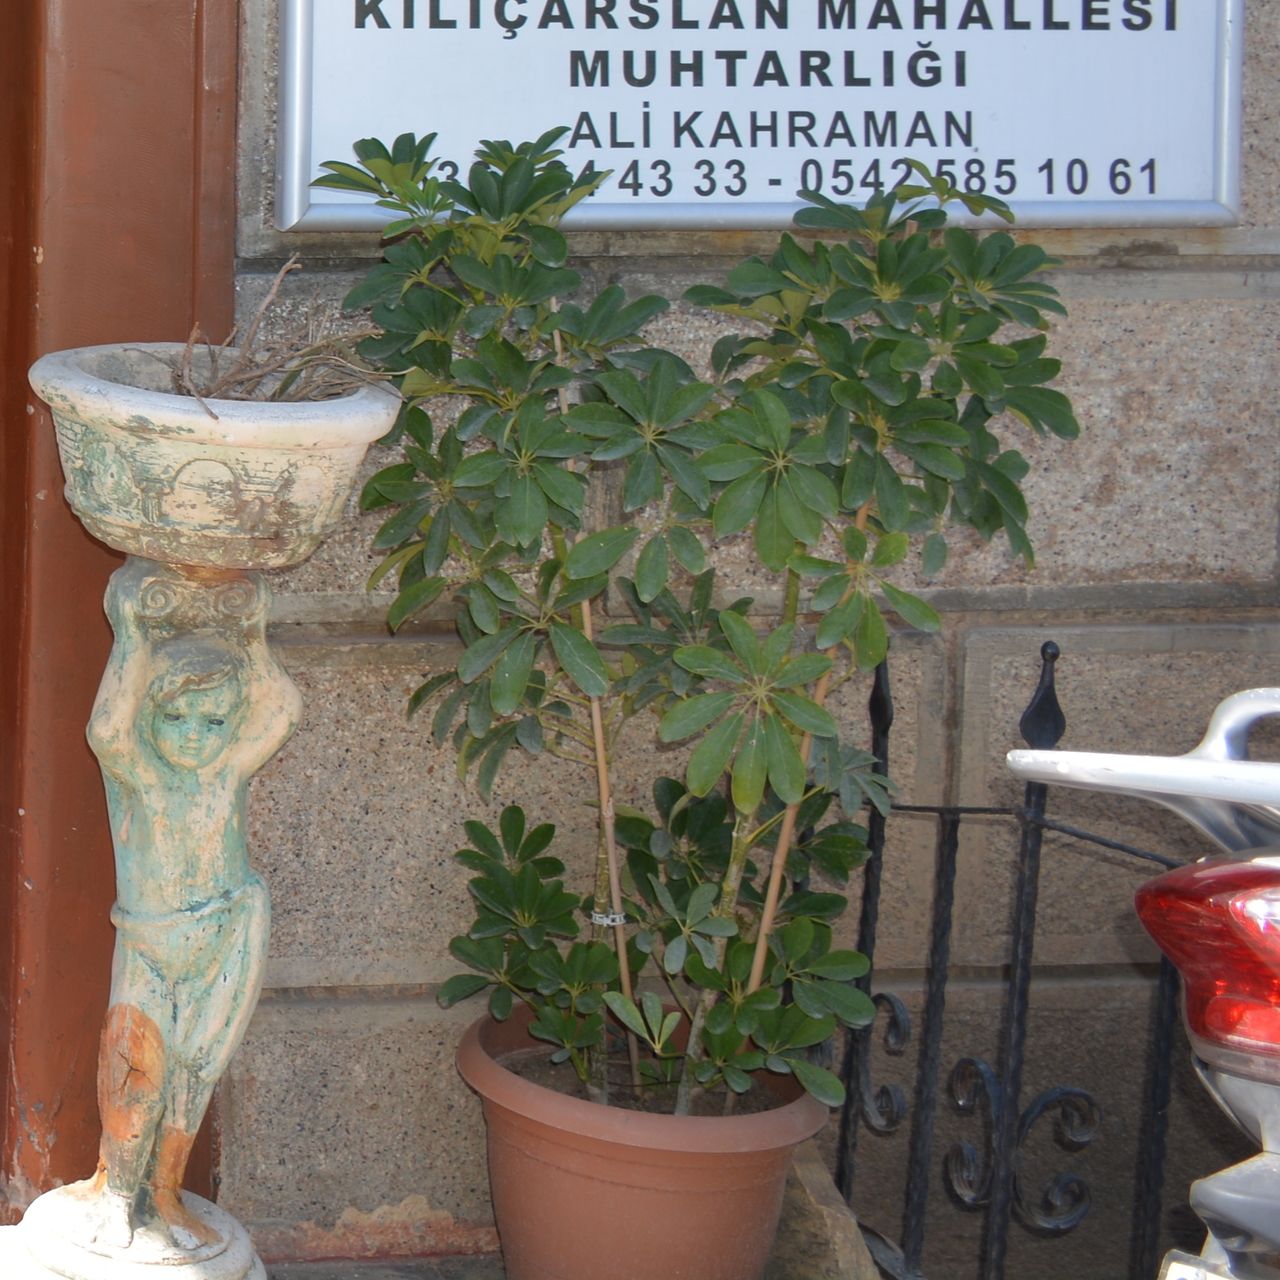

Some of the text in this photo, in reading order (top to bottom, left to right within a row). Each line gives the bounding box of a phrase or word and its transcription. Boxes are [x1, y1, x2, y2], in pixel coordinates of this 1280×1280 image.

[569, 38, 967, 88] MUHTARLIĞI
[568, 102, 973, 149] ALİ KAHRAMAN
[618, 158, 673, 197] 43
[694, 158, 747, 197] 33
[800, 158, 915, 197] 0542
[935, 158, 1018, 197] 585
[1037, 158, 1089, 196] 10
[1108, 158, 1156, 196] 61
